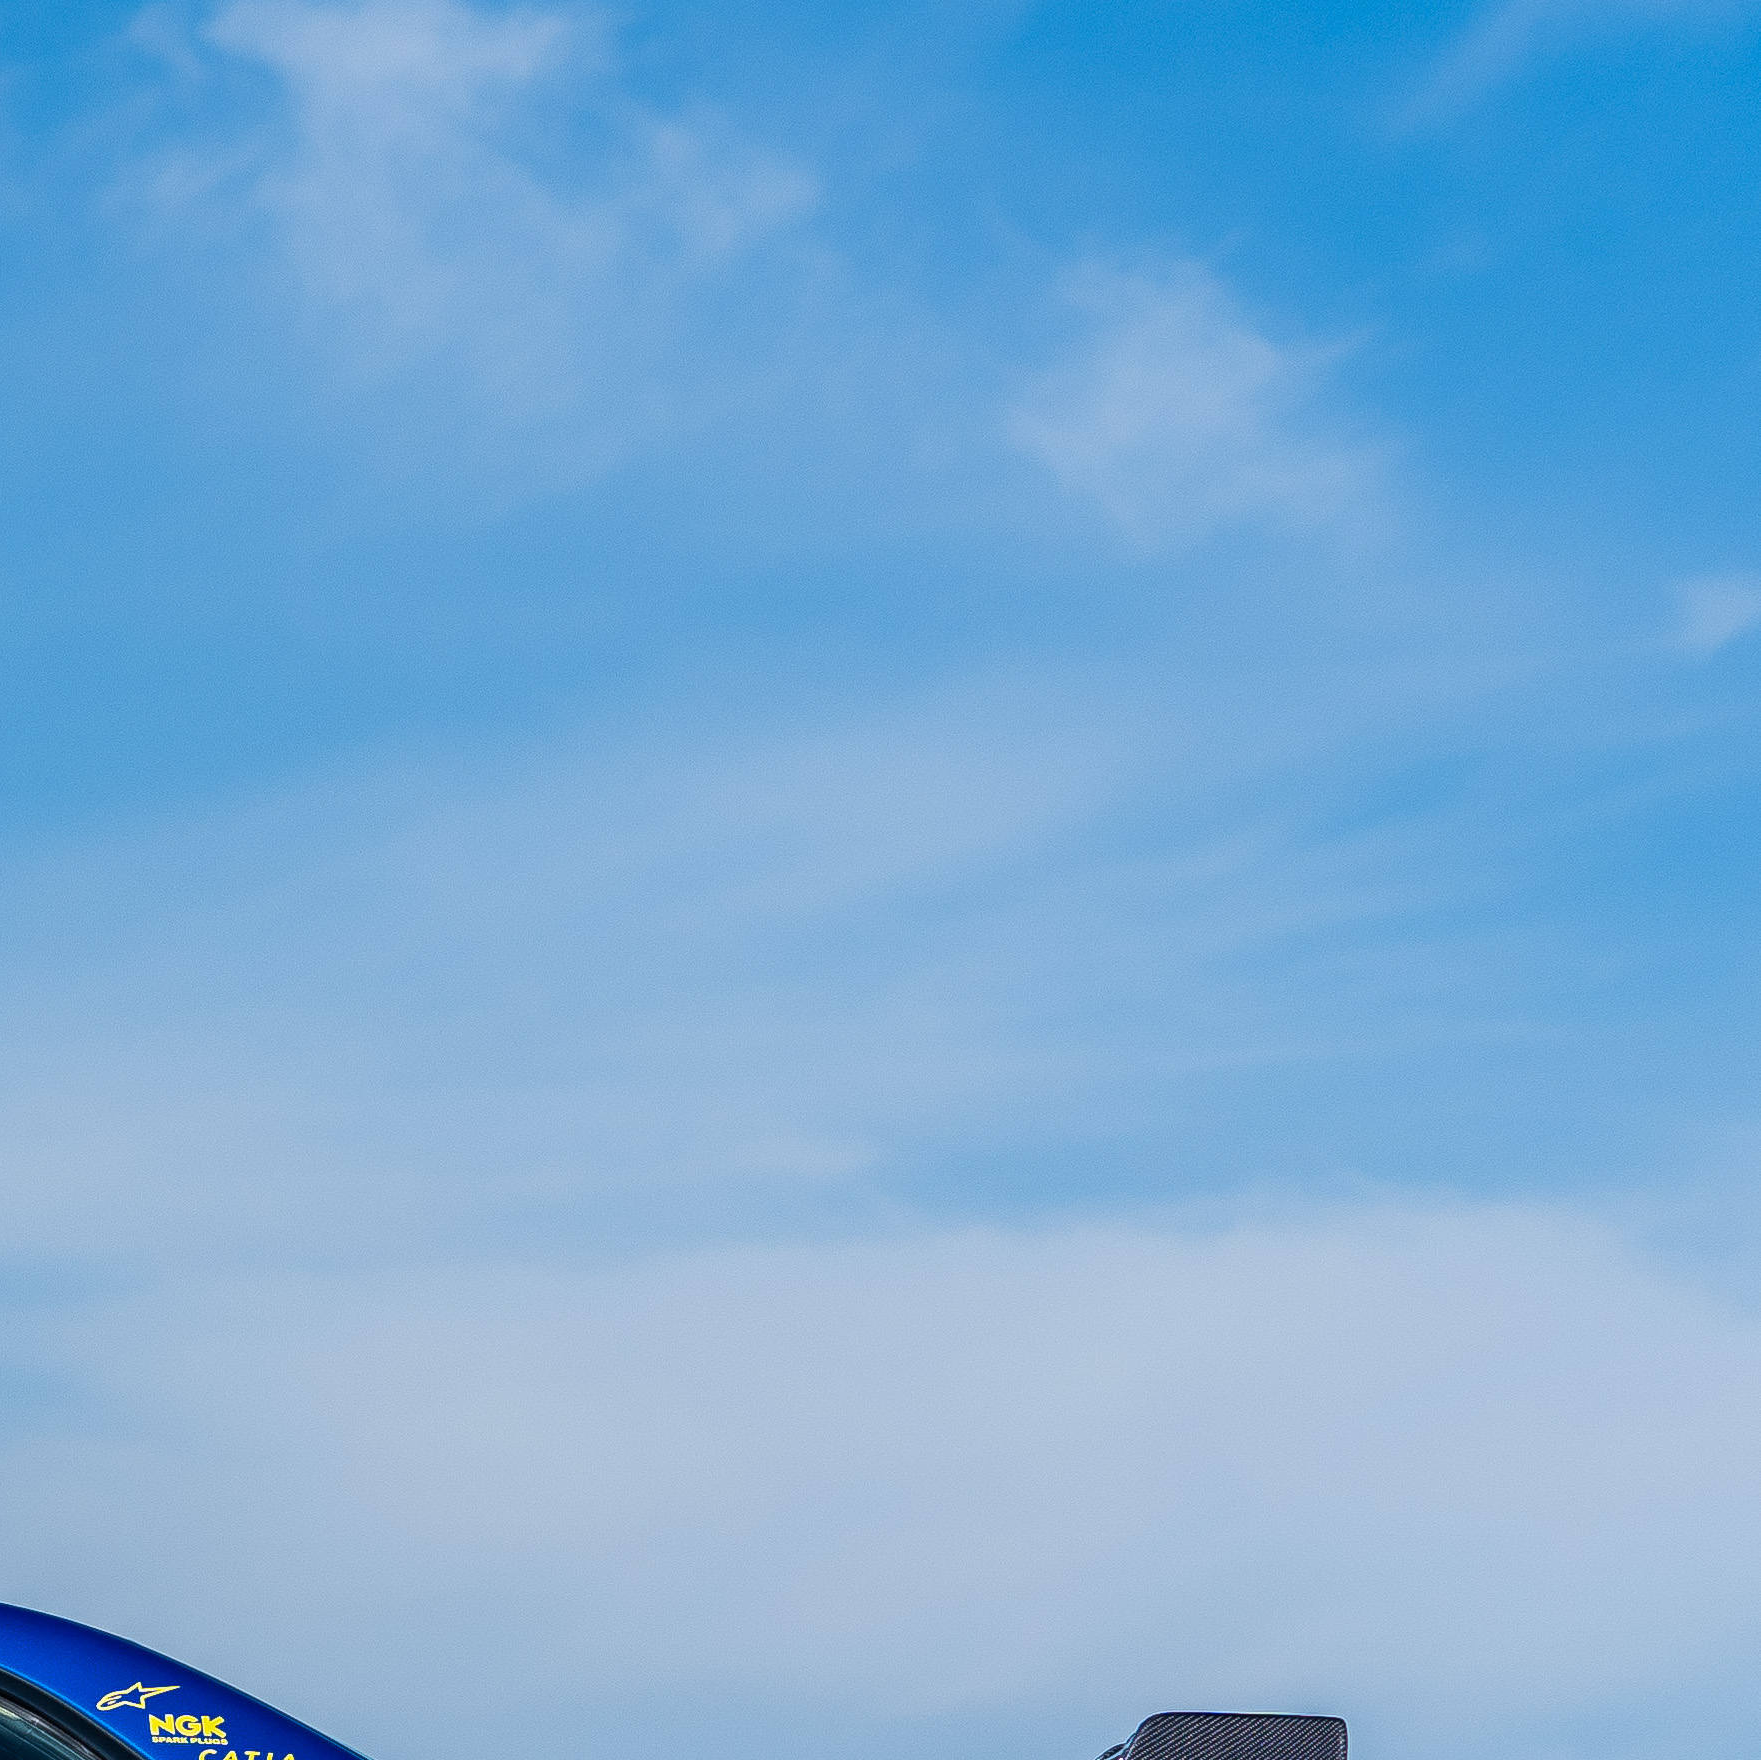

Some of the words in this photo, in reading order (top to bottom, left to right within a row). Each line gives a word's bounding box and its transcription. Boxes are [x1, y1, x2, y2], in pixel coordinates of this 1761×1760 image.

[148, 1713, 227, 1739] NGK
[151, 1736, 189, 1744] SPARK
[190, 1736, 229, 1746] PLUGS
